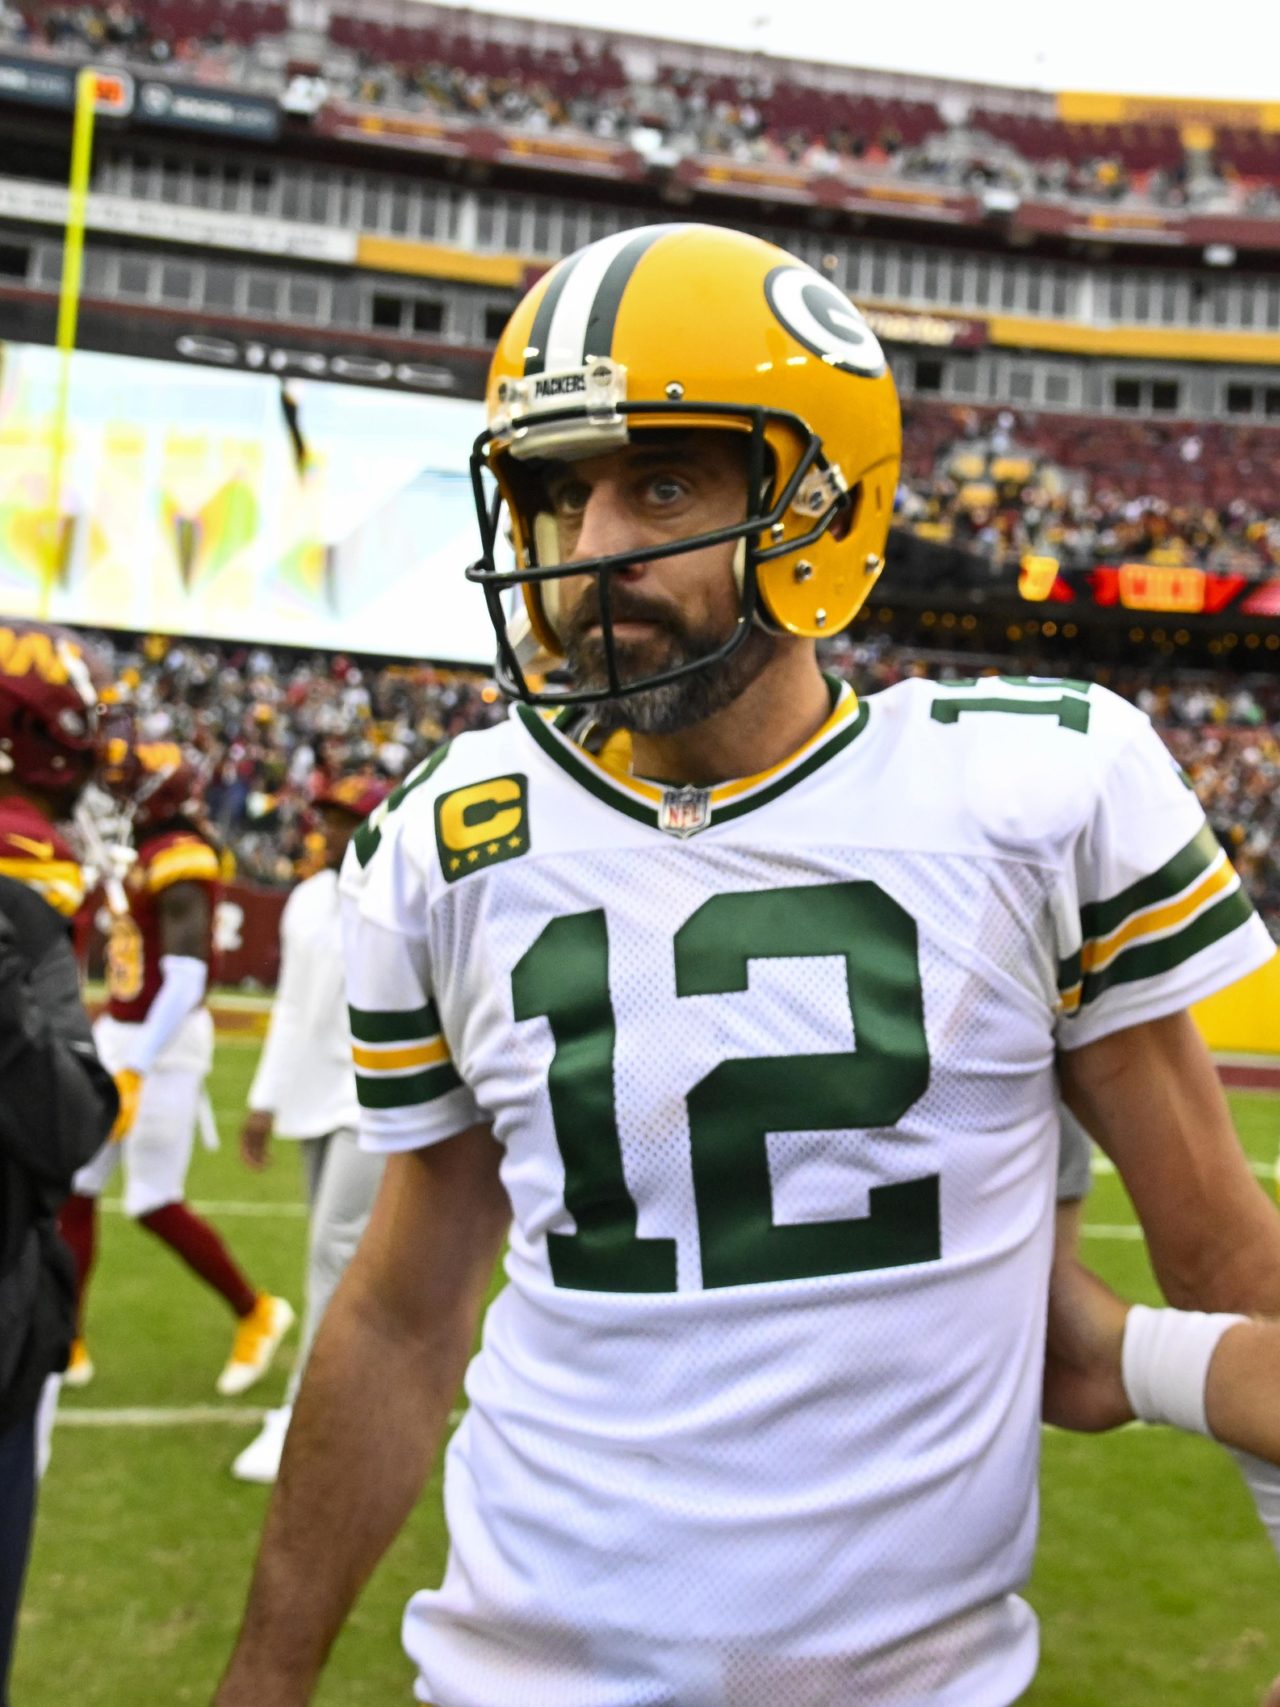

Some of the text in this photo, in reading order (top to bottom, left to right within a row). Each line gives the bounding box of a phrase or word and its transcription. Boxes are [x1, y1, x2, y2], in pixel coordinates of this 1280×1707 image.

[771, 268, 885, 370] G
[535, 375, 586, 397] PACKERS
[440, 778, 522, 852] C
[667, 801, 701, 829] NFL
[511, 880, 942, 1294] 12
